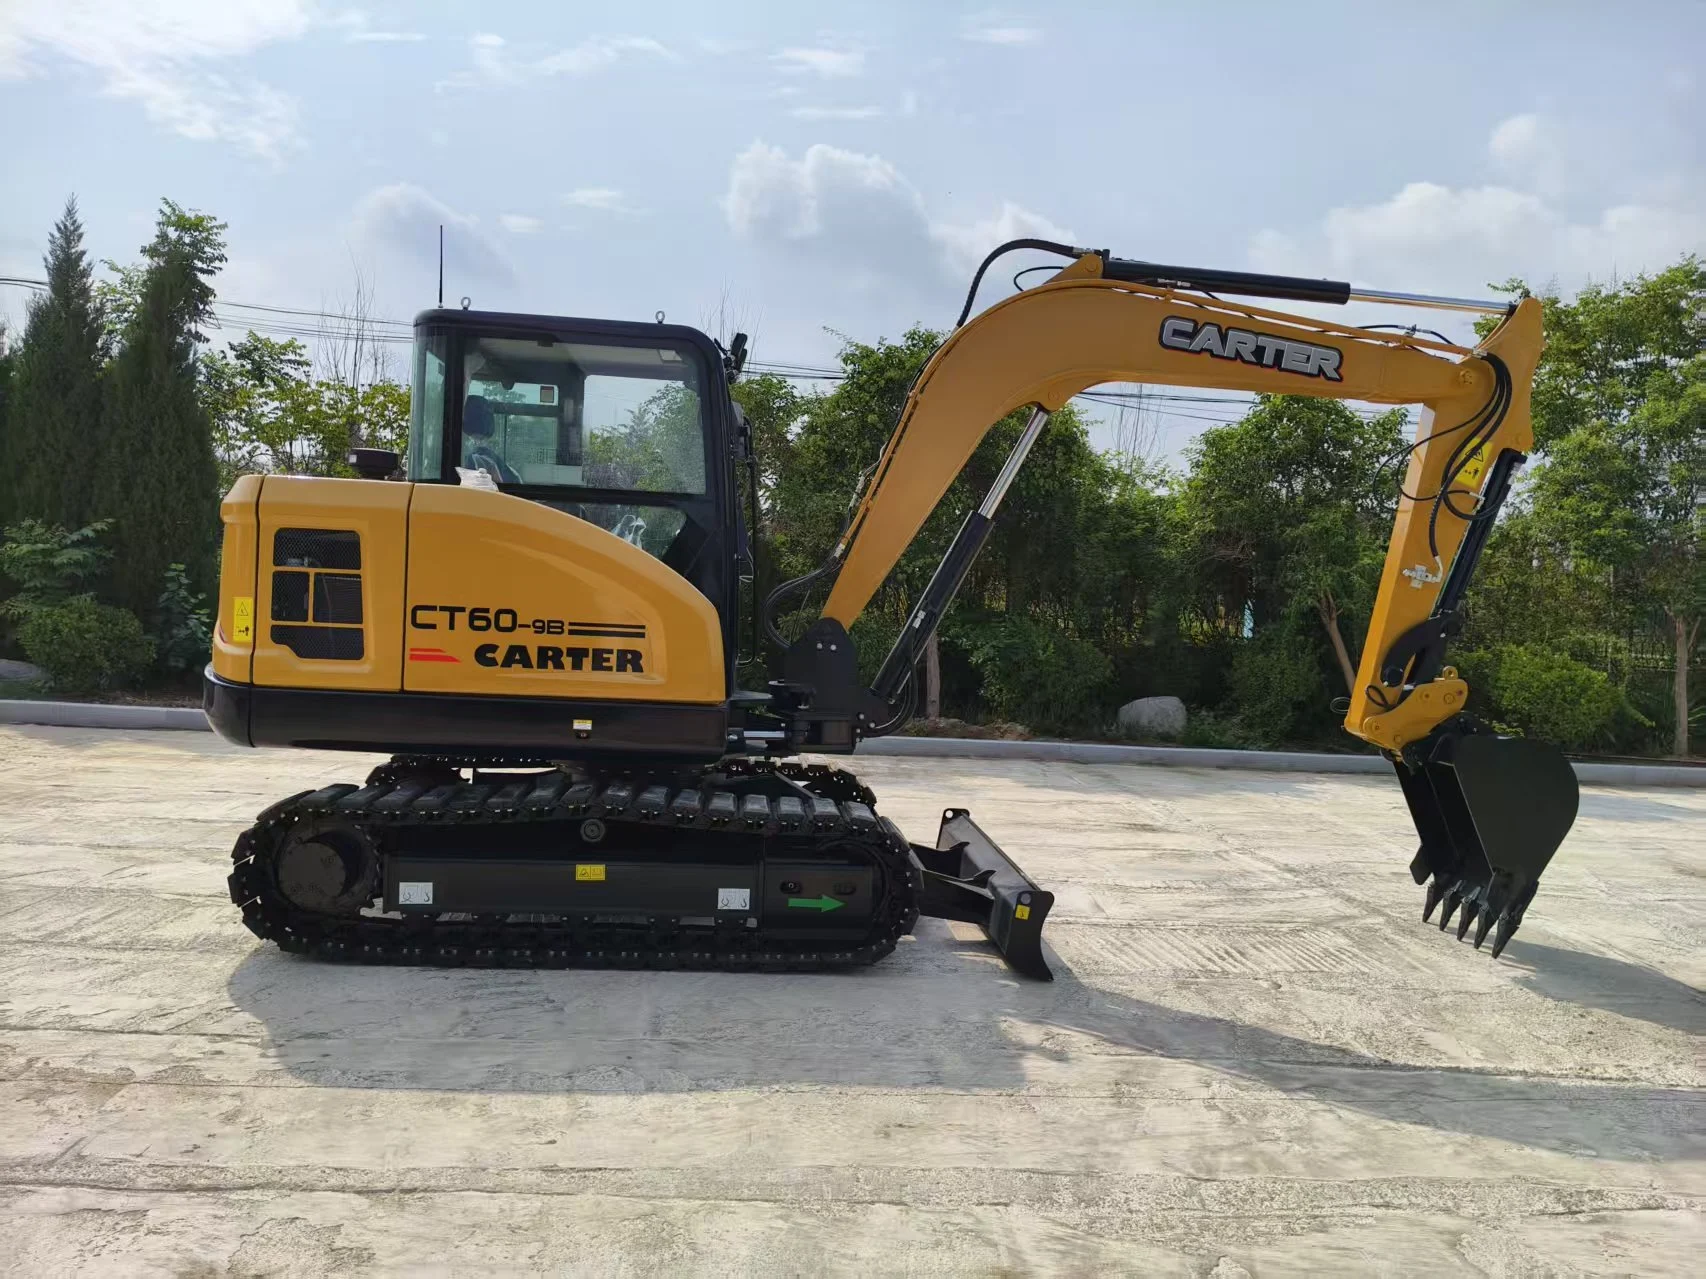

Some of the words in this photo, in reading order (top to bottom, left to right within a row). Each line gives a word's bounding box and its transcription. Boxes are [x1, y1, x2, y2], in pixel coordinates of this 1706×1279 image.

[1160, 316, 1343, 381] CARTER
[410, 604, 565, 635] CT60-9B
[474, 643, 644, 673] CARTER
